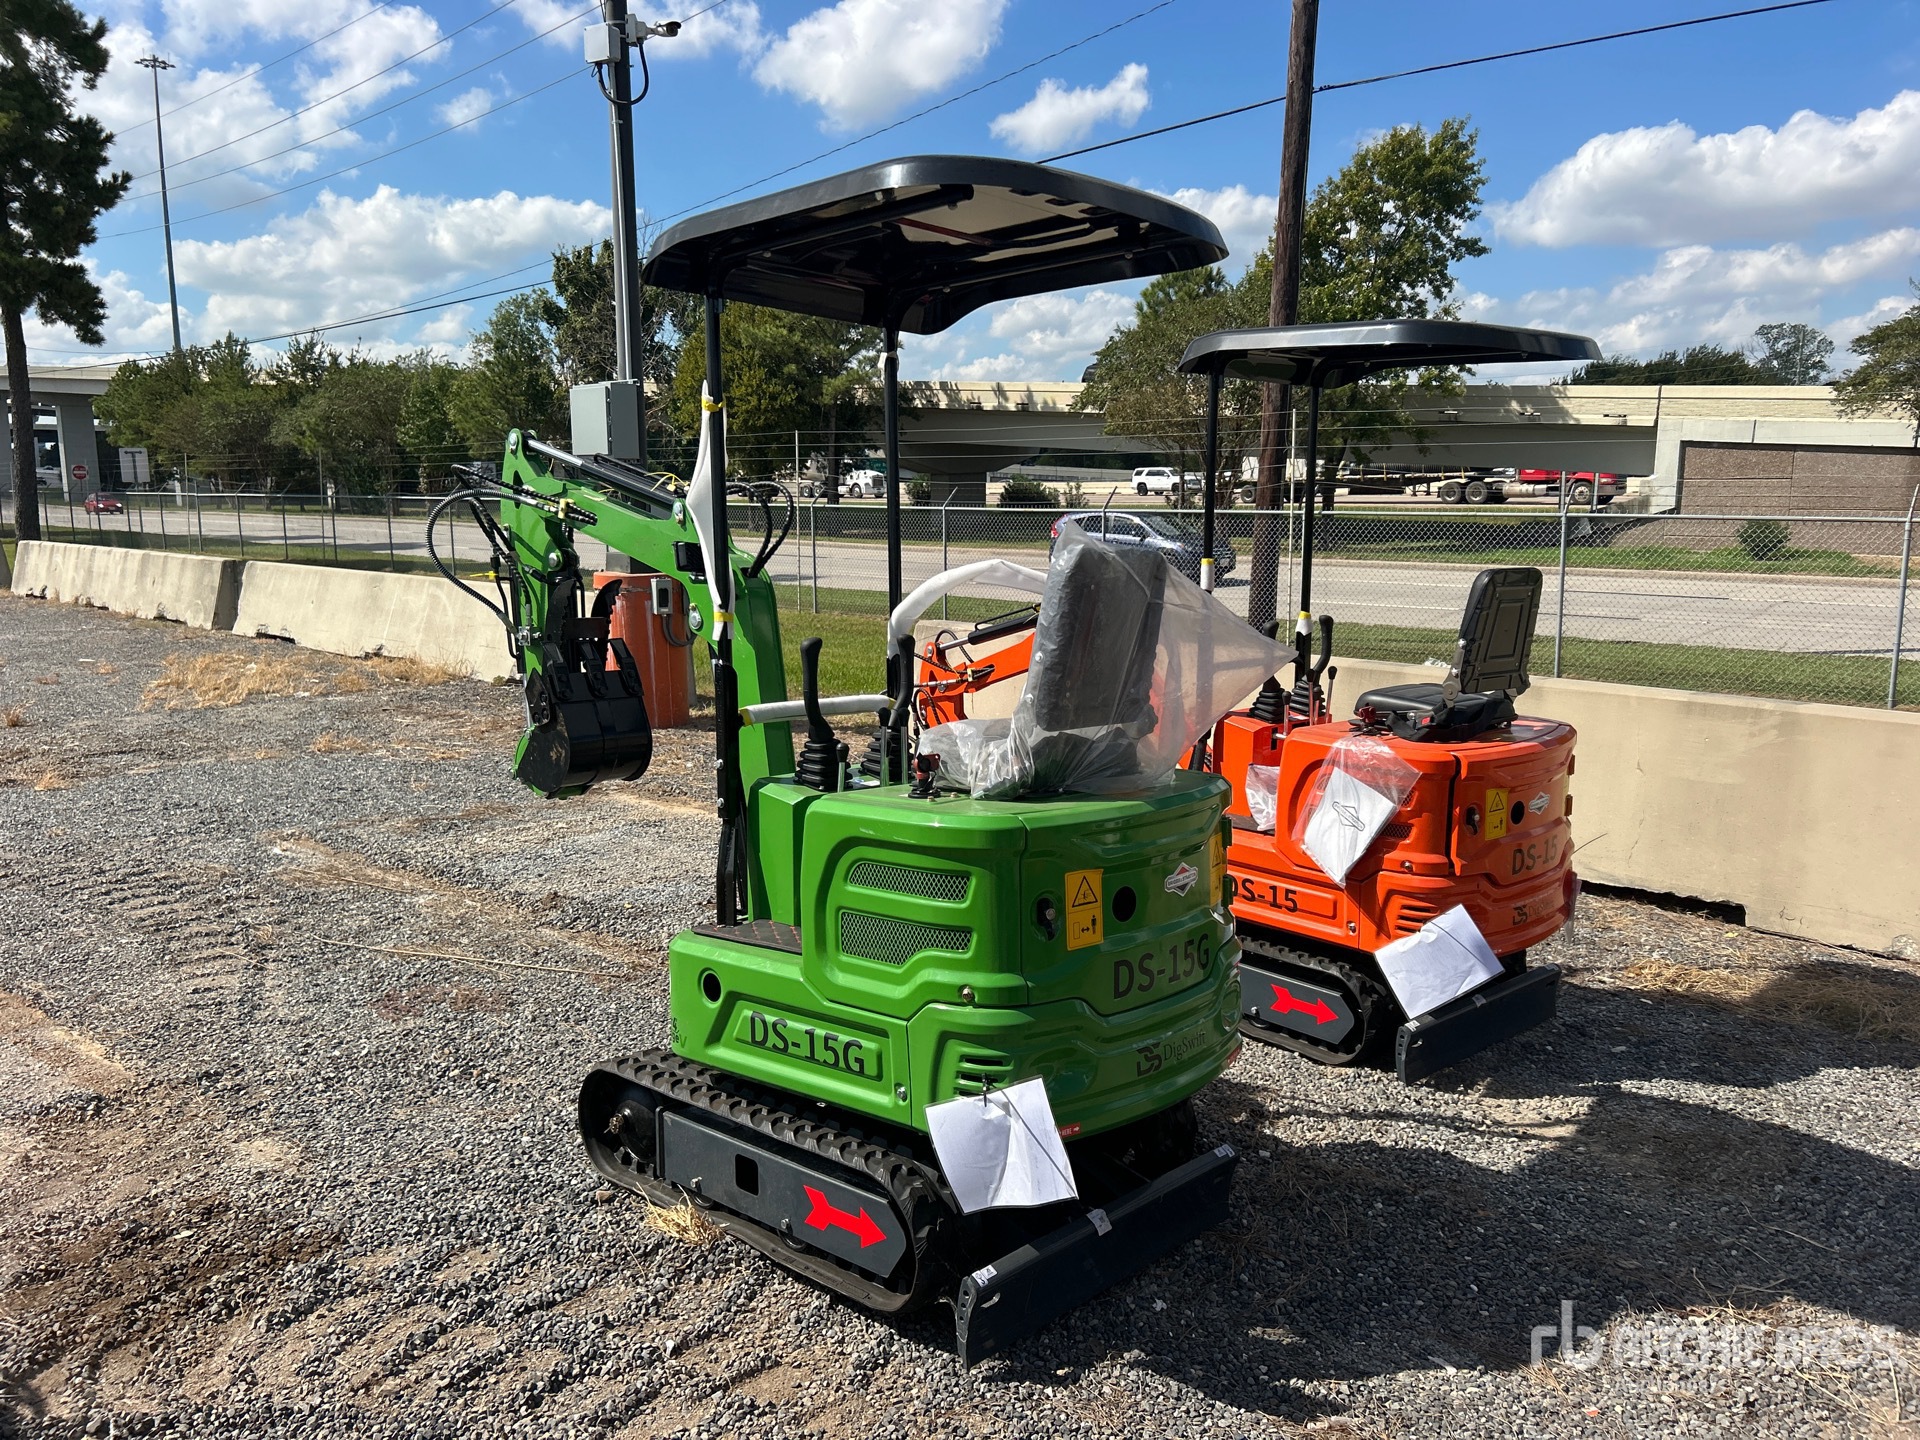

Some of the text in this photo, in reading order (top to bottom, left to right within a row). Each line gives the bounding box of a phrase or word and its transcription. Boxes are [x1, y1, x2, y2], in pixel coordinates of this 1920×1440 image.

[1511, 834, 1558, 876] DS-15
[1113, 933, 1210, 1000] DS-15G
[750, 1010, 865, 1075] DS-15G
[1163, 1030, 1206, 1061] DigSwift
